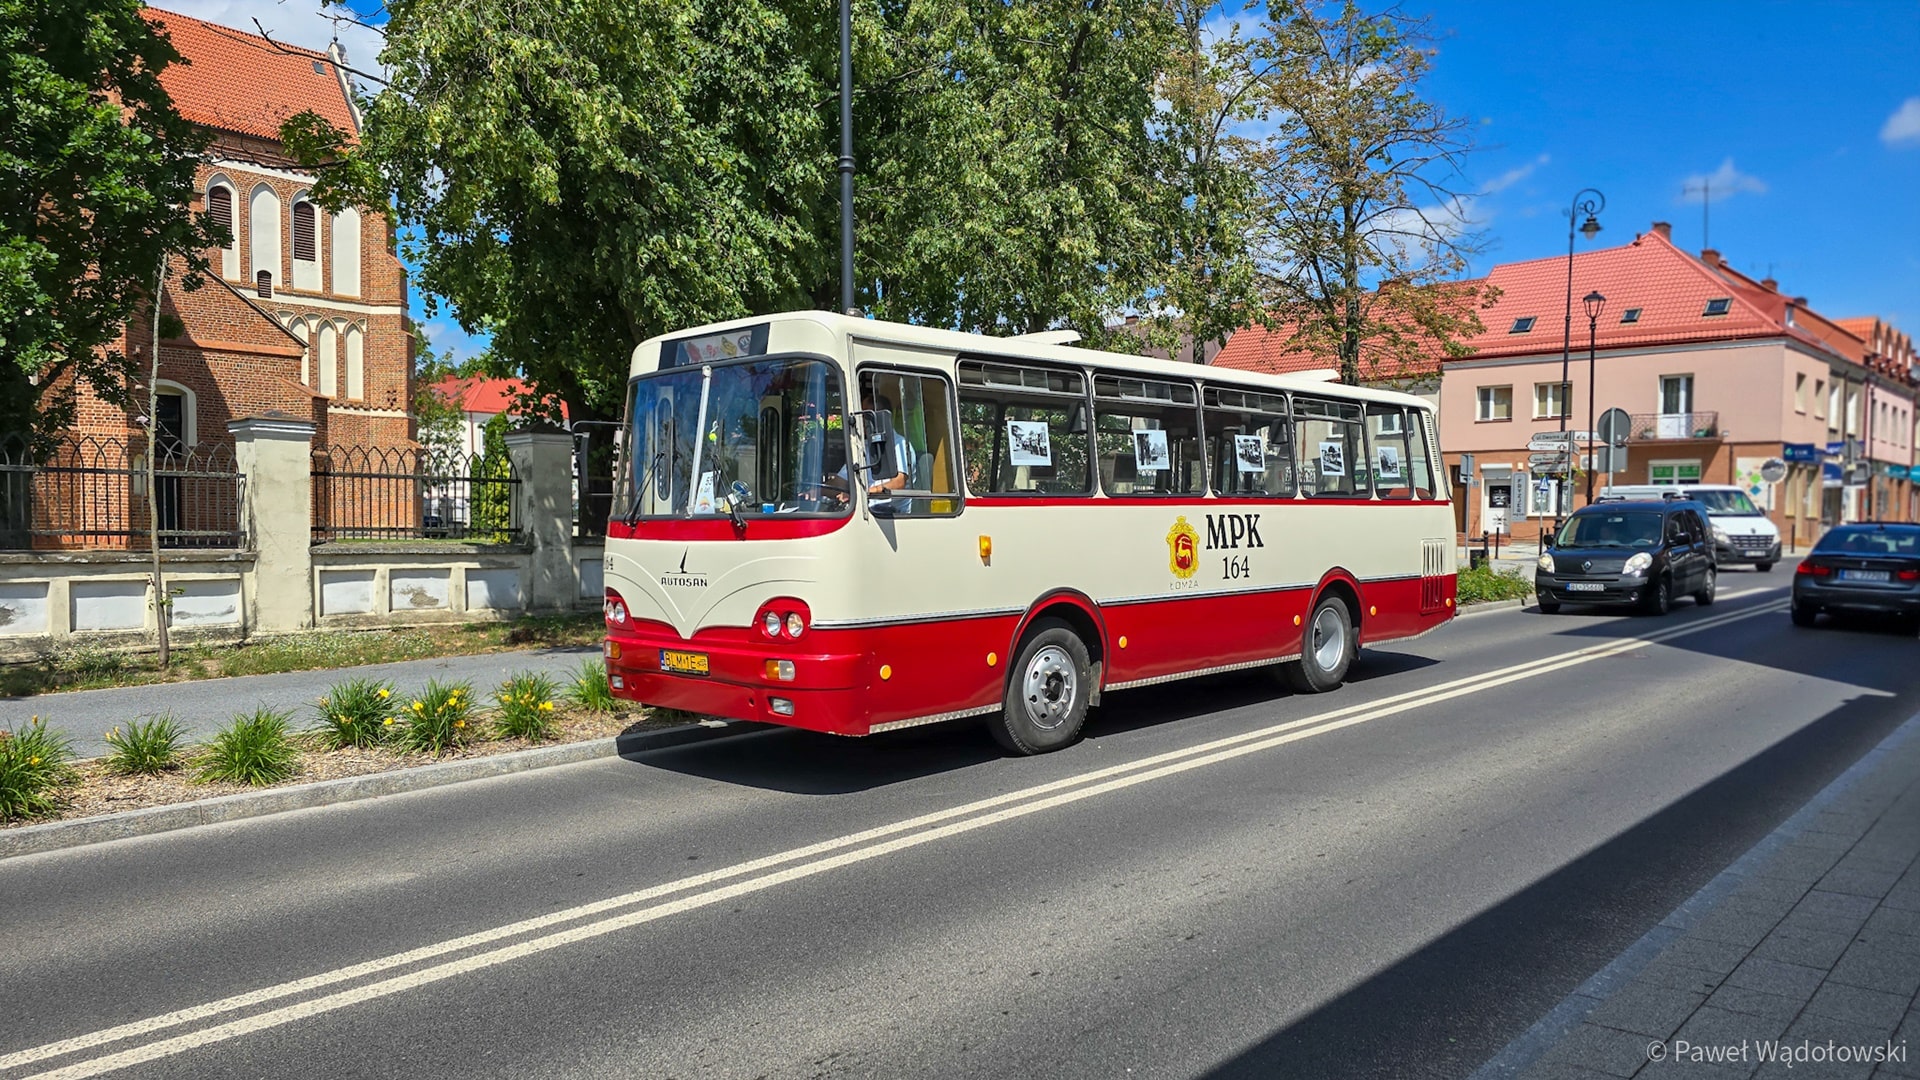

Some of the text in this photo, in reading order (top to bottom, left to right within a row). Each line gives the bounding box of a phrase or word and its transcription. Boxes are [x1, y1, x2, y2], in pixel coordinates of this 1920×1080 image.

[1206, 514, 1264, 549] MPK
[604, 556, 613, 570] 64
[1222, 555, 1249, 579] 164
[661, 577, 707, 587] AUTOSAN
[1170, 580, 1199, 590] ŁOMŻA
[665, 652, 683, 668] BLM
